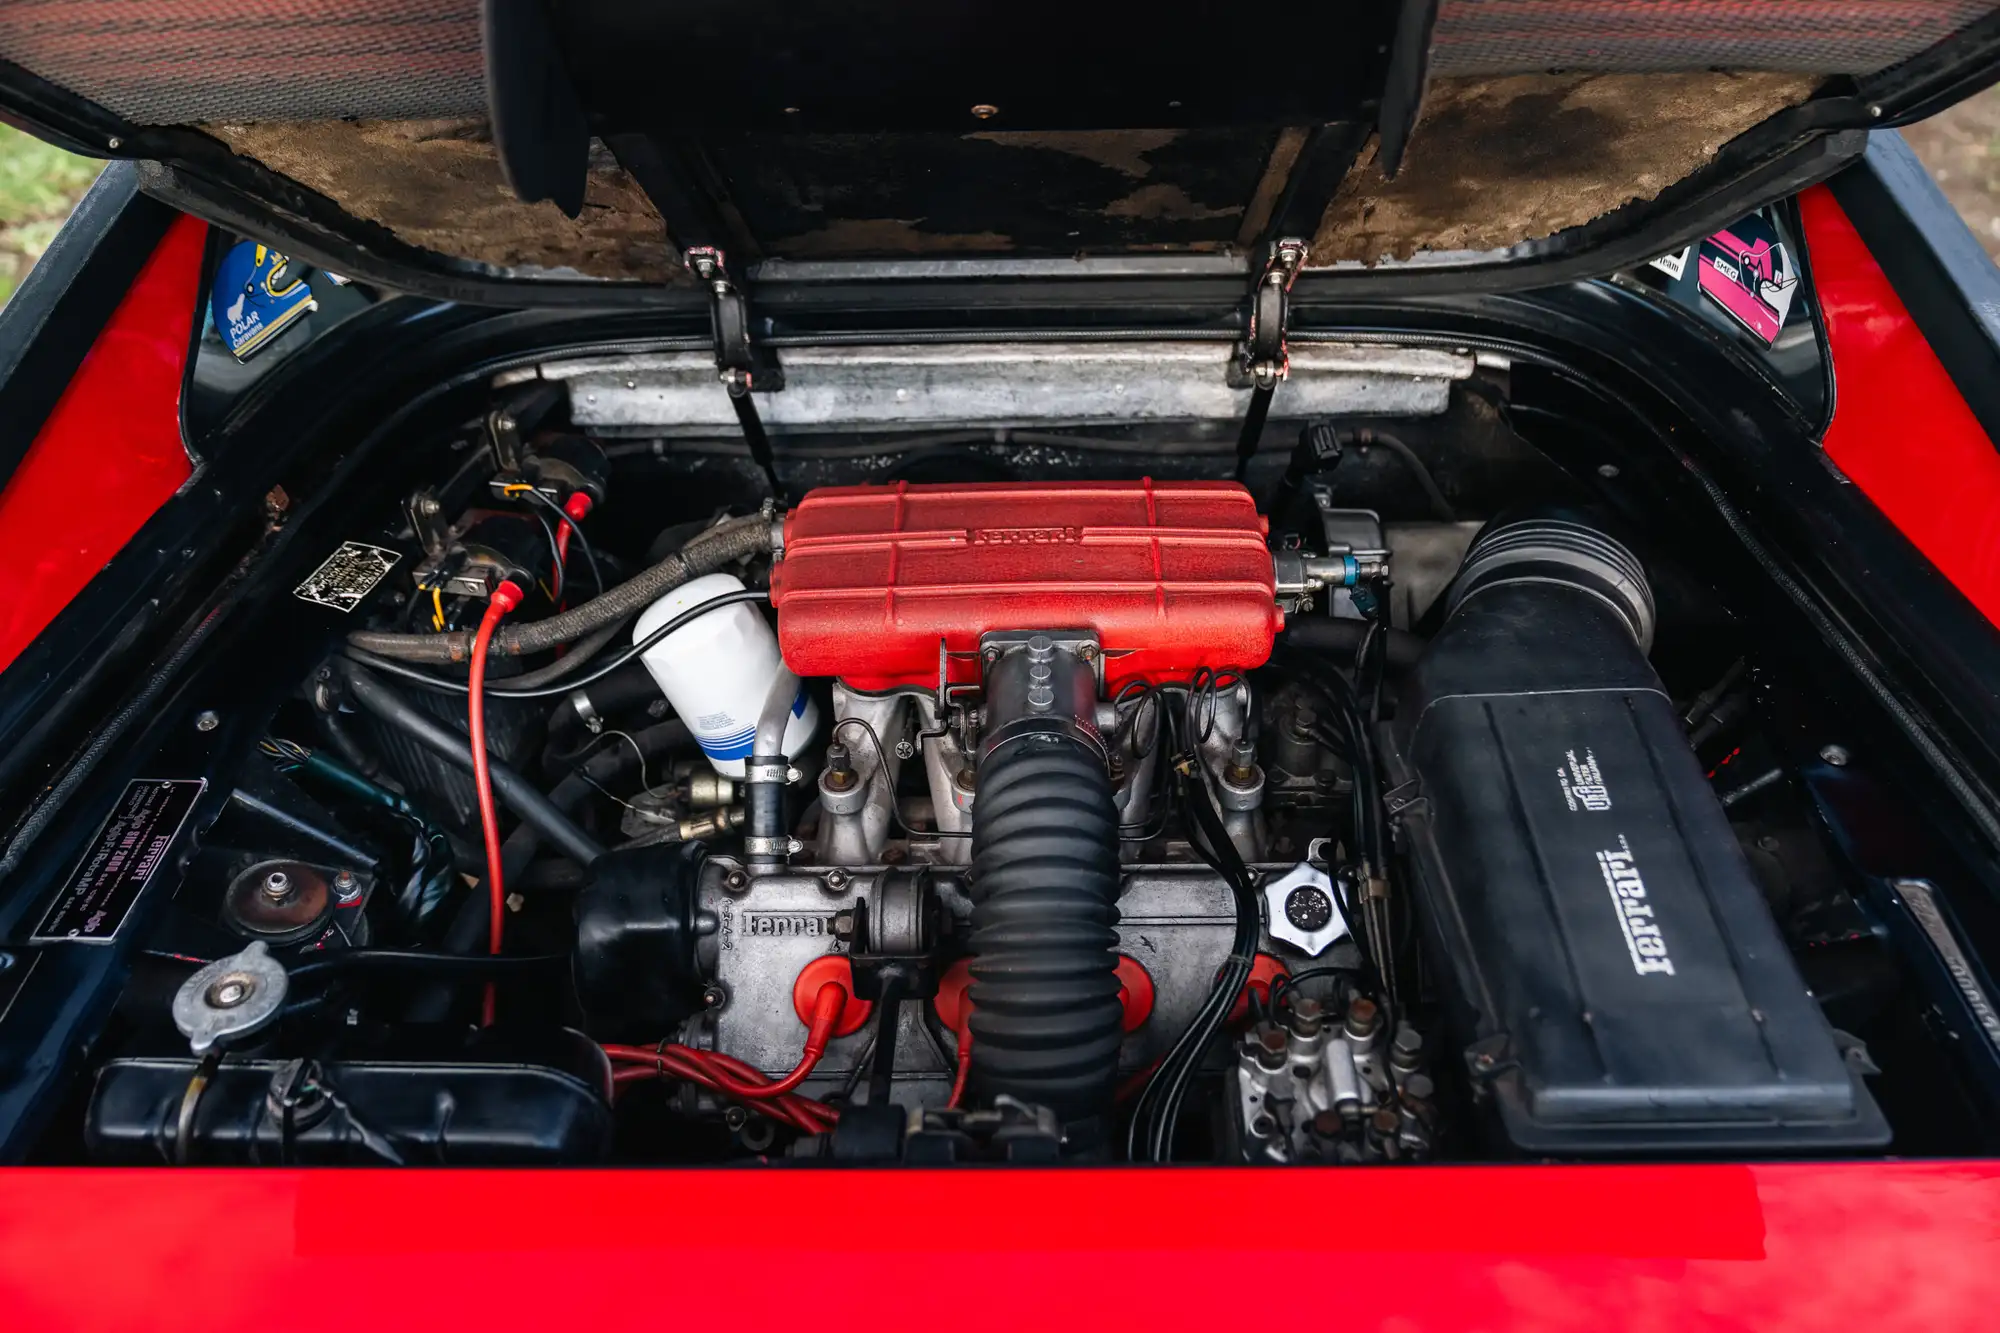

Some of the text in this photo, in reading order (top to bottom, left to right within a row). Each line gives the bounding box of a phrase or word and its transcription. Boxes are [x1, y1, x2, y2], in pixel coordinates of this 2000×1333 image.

[1715, 260, 1737, 279] SMEG
[229, 310, 261, 339] POLAR
[106, 819, 127, 840] Agip
[131, 809, 150, 829] Agip
[120, 832, 139, 848] SINT
[84, 853, 108, 876] Rotra
[105, 851, 128, 871] 2000
[131, 835, 170, 880] Ferrari
[75, 878, 93, 895] MP
[84, 910, 106, 932] Agip
[1596, 850, 1676, 976] Ferrari
